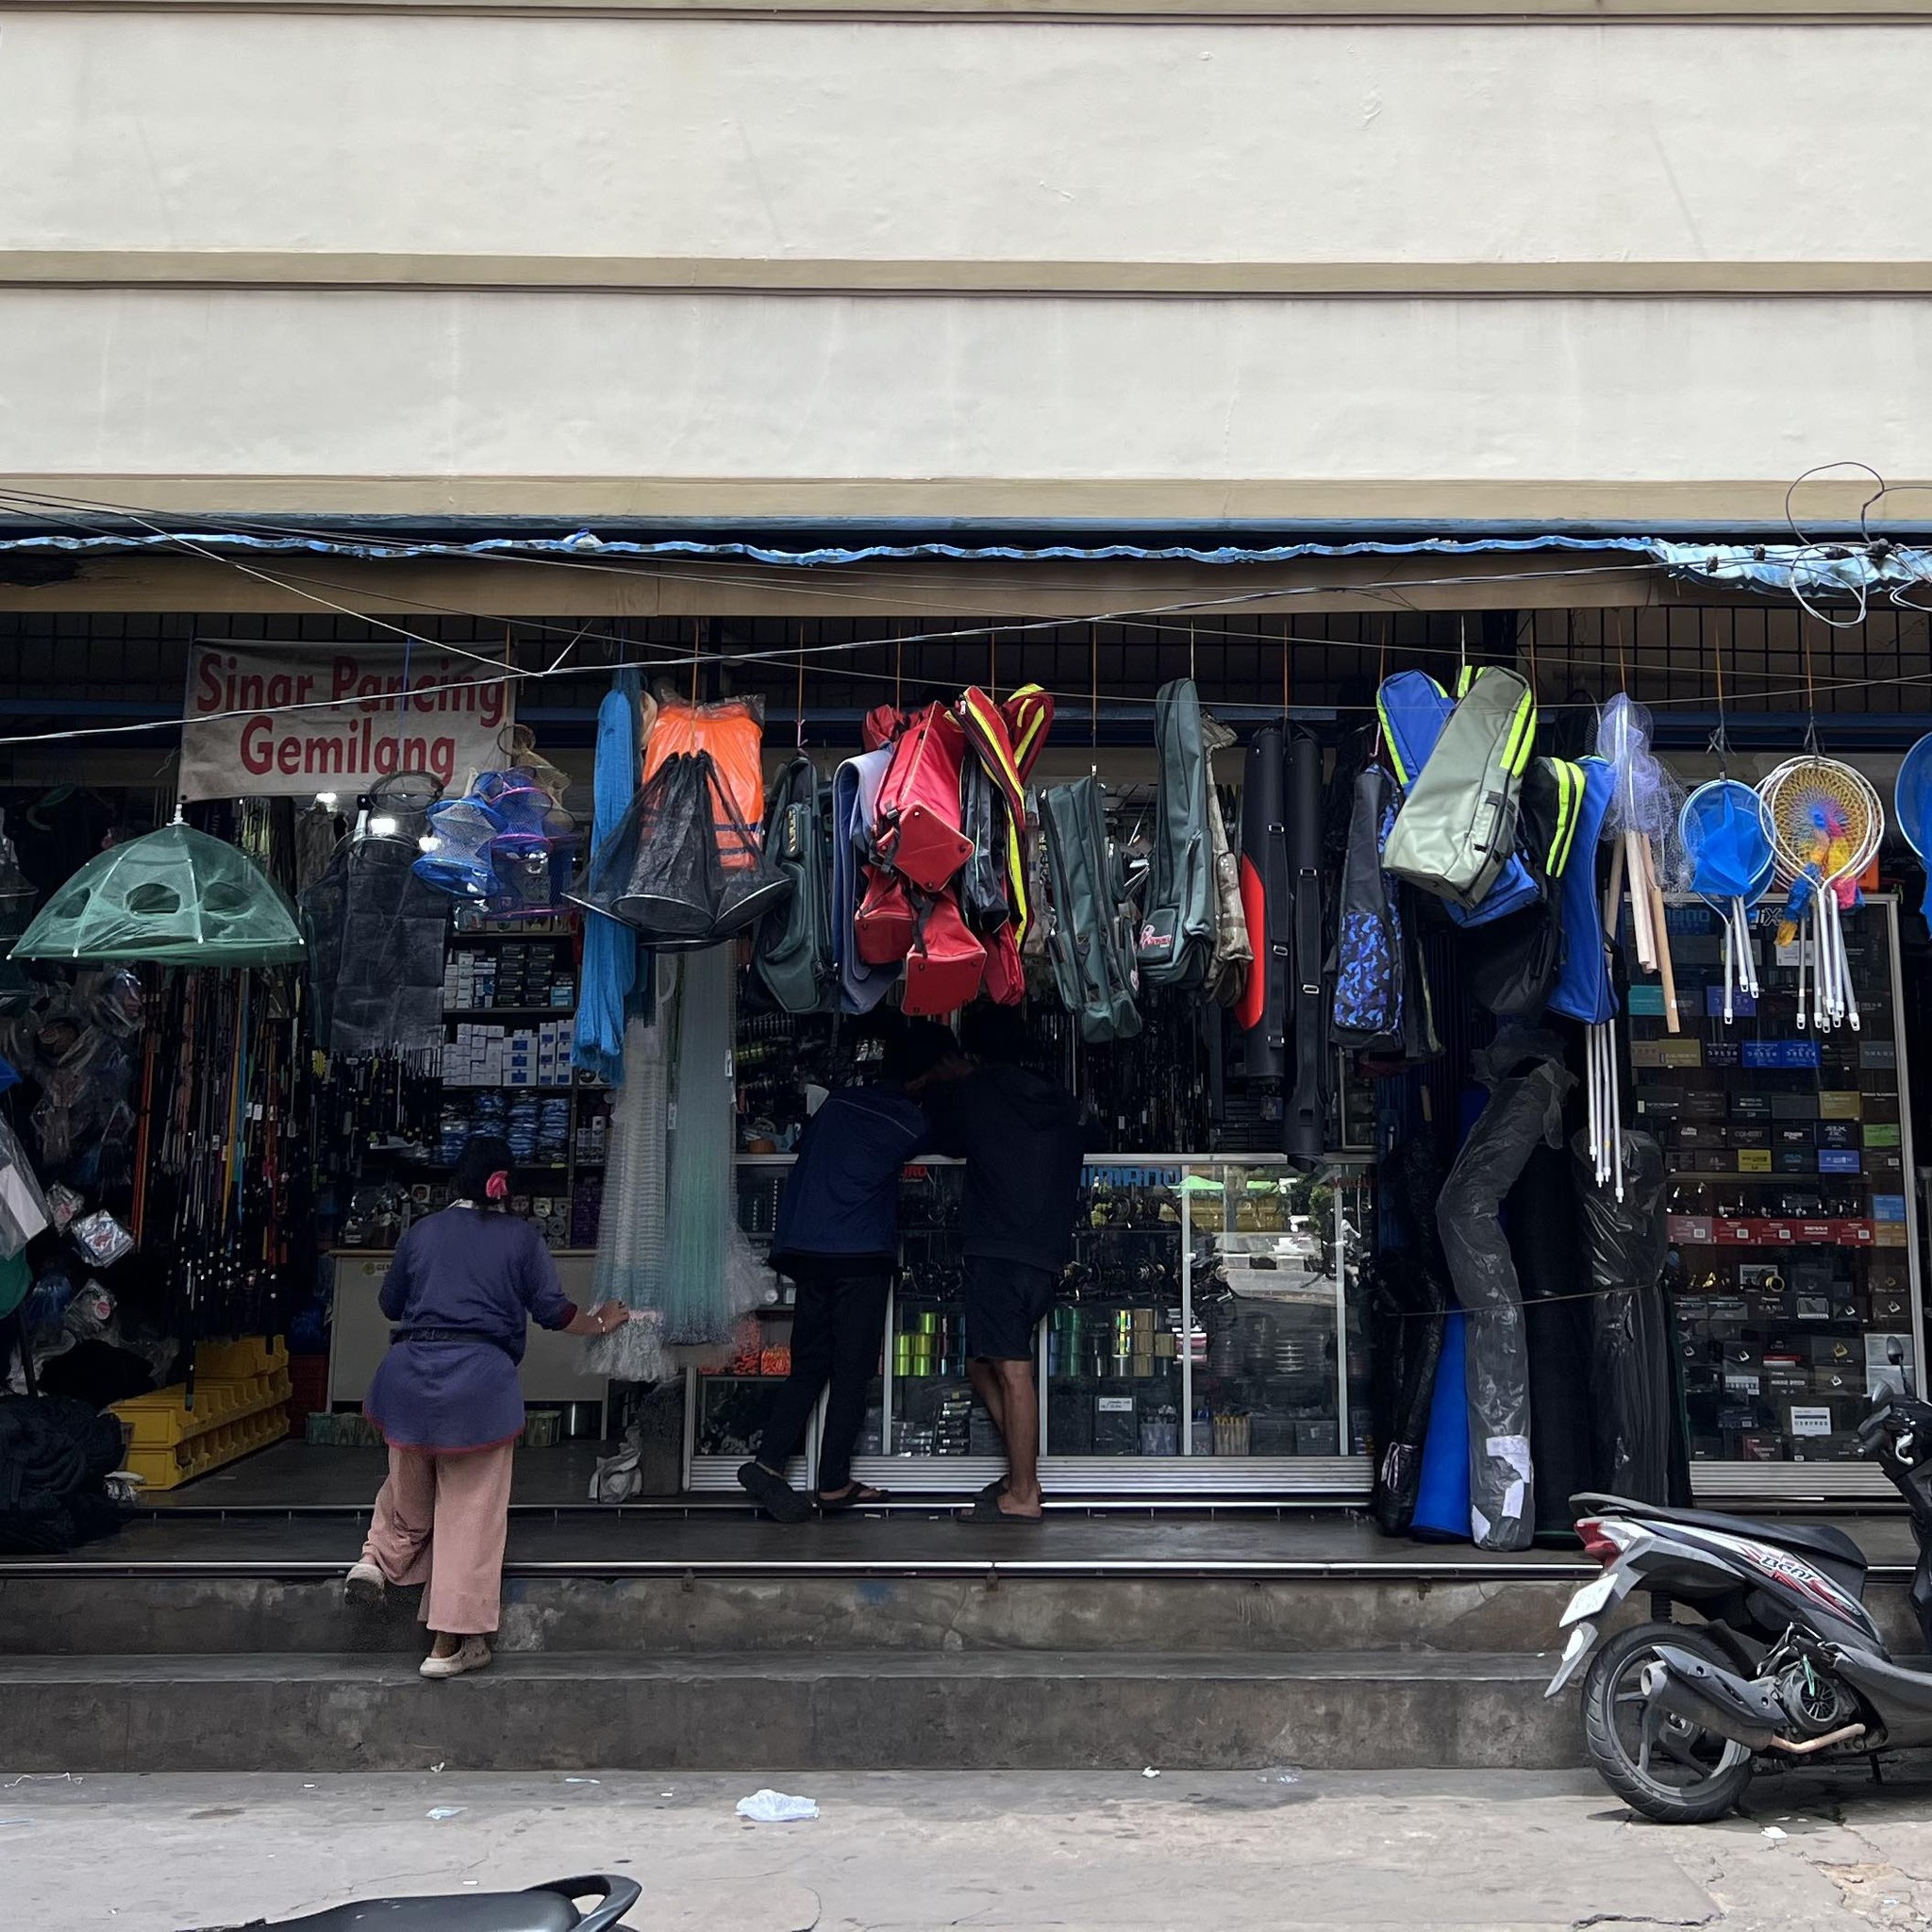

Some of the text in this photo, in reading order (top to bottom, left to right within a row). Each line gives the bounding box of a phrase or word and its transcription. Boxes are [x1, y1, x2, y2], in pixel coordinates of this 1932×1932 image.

[197, 653, 504, 728] Sinar Pancing
[240, 715, 456, 789] Gemilang
